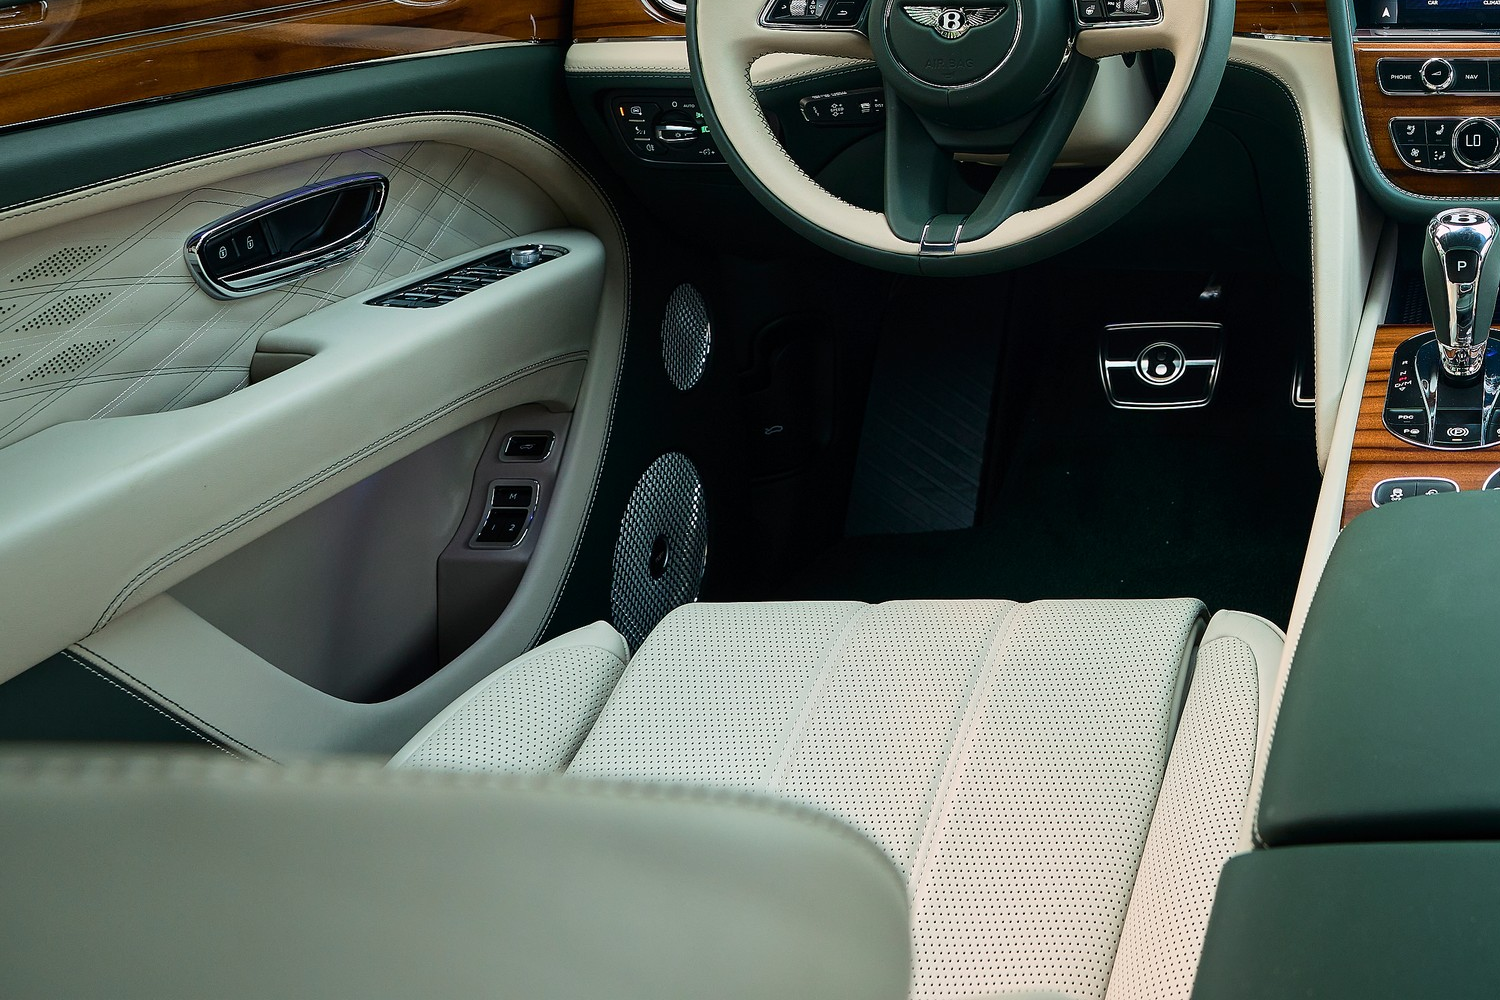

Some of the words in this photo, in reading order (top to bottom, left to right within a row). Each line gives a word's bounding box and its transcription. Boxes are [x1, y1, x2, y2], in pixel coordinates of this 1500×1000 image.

[943, 10, 961, 30] B
[925, 59, 944, 70] AIR
[950, 59, 976, 68] BAG
[1466, 134, 1481, 147] LO
[1458, 261, 1467, 272] P
[508, 523, 516, 532] 2
